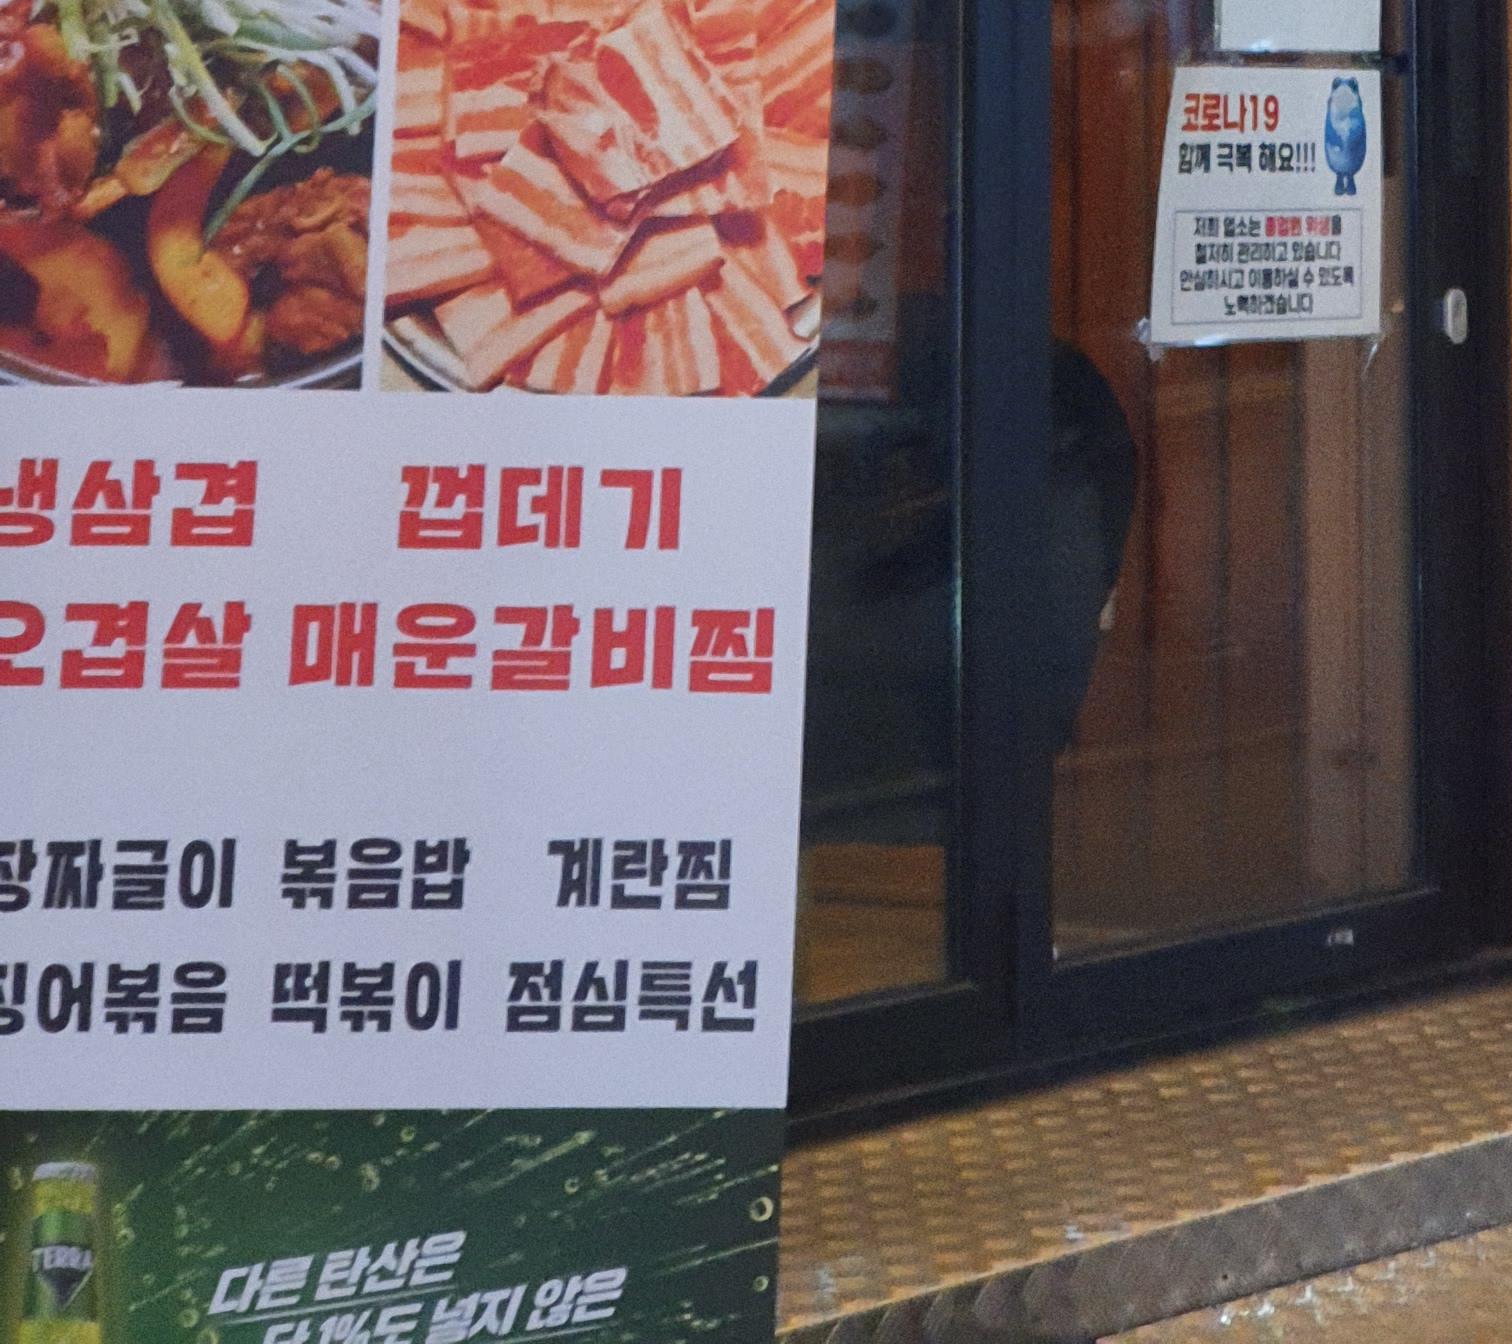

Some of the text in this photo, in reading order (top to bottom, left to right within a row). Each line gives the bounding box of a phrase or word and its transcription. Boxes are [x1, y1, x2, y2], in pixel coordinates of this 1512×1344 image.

[1181, 93, 1281, 133] 코로나19
[1178, 142, 1212, 174] 함께
[1216, 142, 1253, 173] 극복
[397, 463, 683, 551] 껍데기
[288, 602, 776, 695] 매운갈비찜
[280, 837, 472, 911] 볶음밥
[547, 838, 733, 911] 계란찜
[271, 960, 463, 1035] 떡볶이
[505, 961, 759, 1035] 점심특선
[207, 1230, 468, 1315] 다른 탄산은
[525, 1266, 629, 1332] 않은
